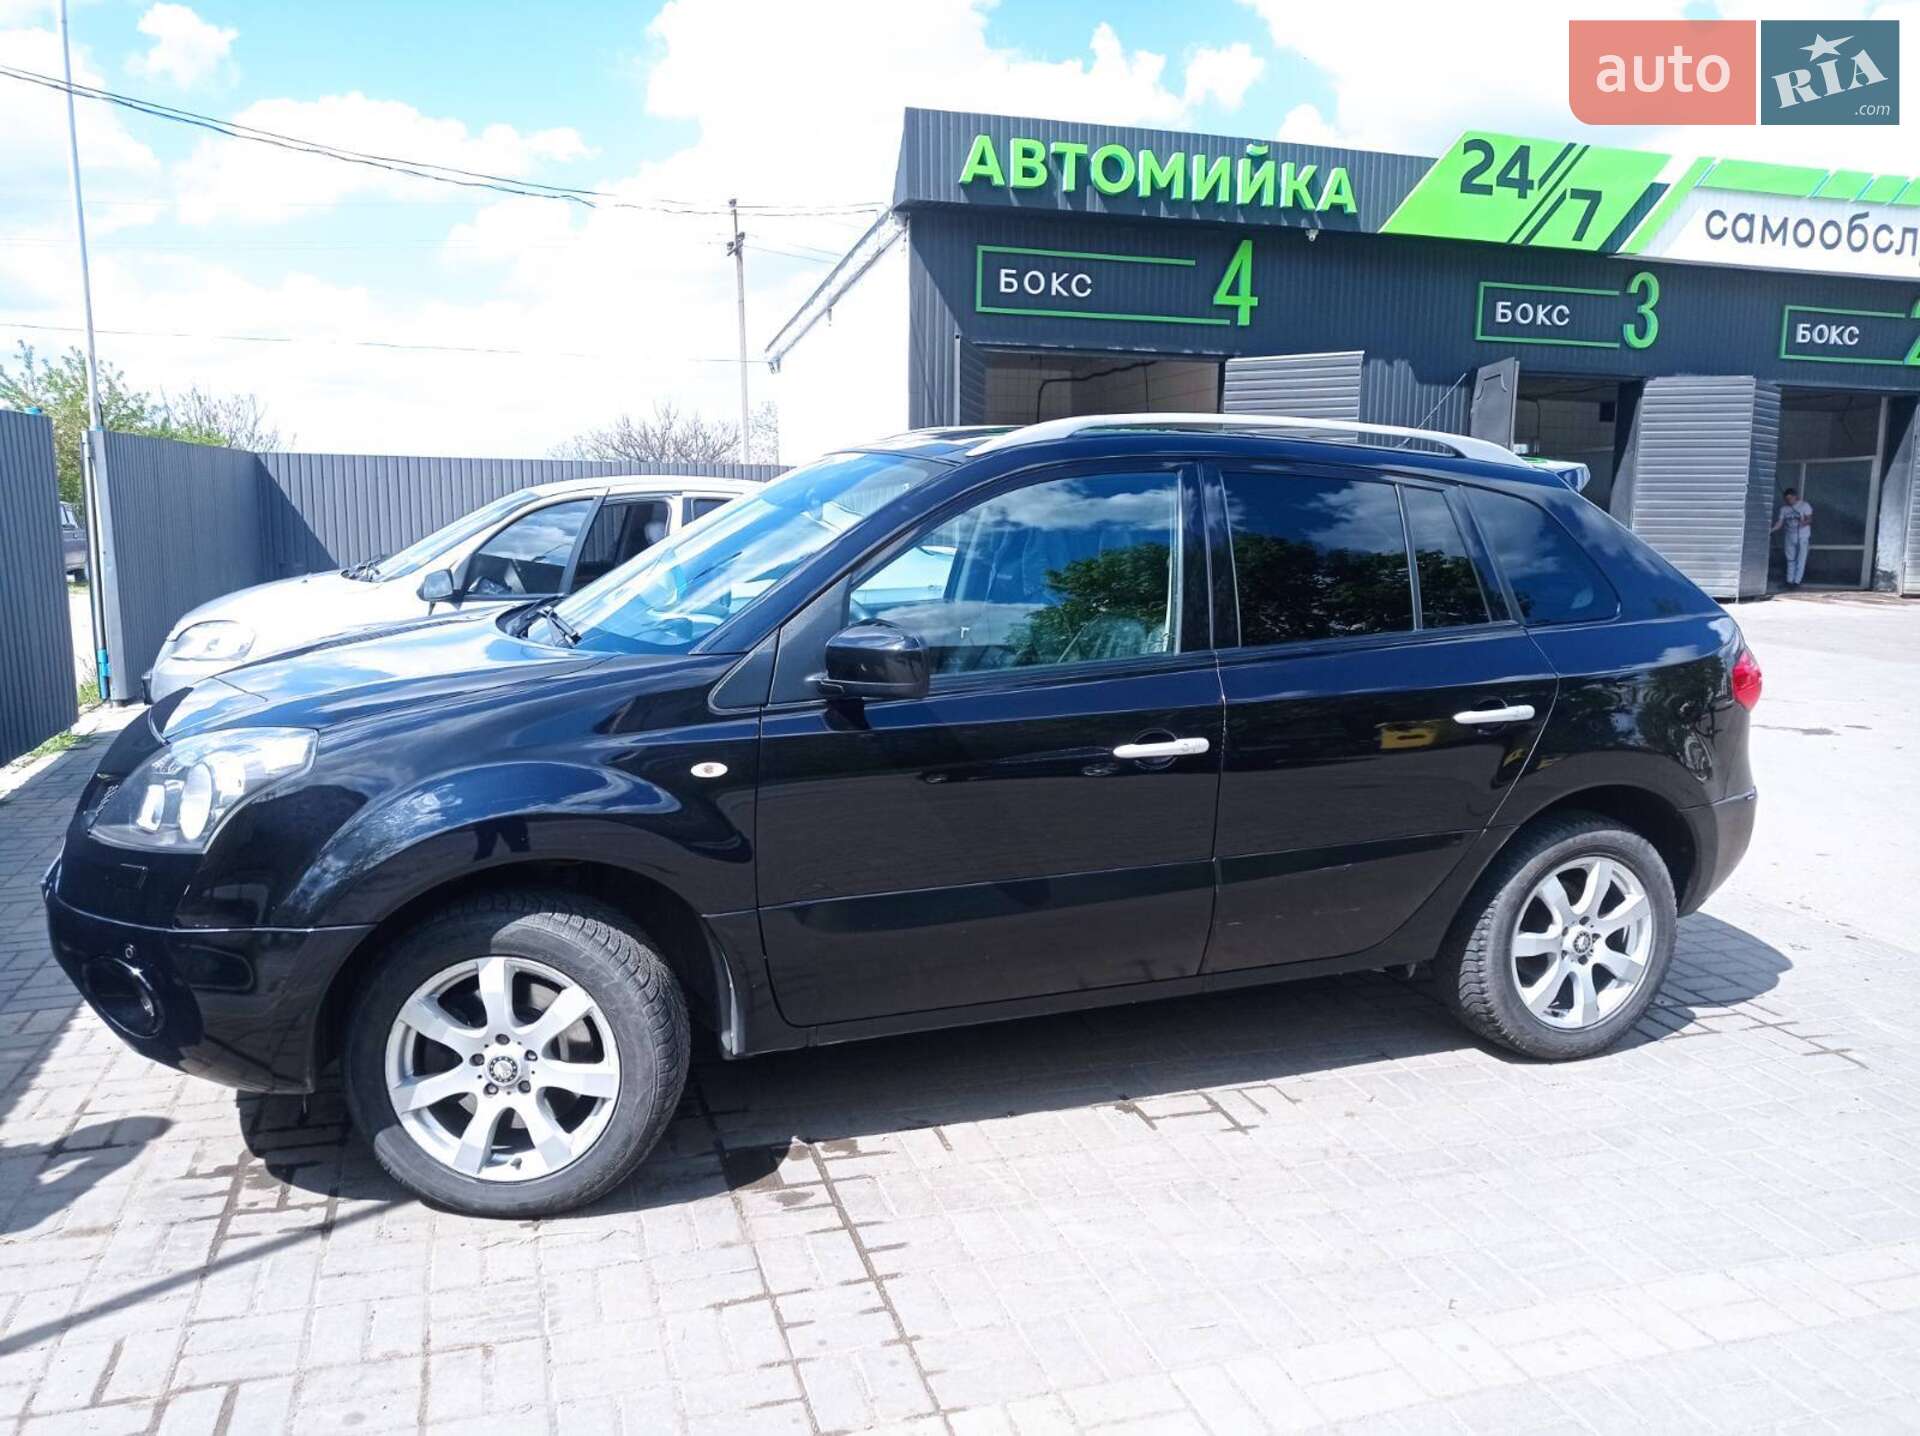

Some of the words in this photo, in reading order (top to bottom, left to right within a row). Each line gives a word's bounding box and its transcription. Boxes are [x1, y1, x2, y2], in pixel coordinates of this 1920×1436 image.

[958, 135, 1357, 214] АВТОМИЙКА
[1704, 208, 1920, 267] самообсл
[998, 268, 1093, 298] БОКС
[1213, 239, 1259, 326] 4
[1495, 301, 1570, 326] БОКС
[1622, 271, 1661, 350] 3
[1795, 323, 1860, 345] БОКС
